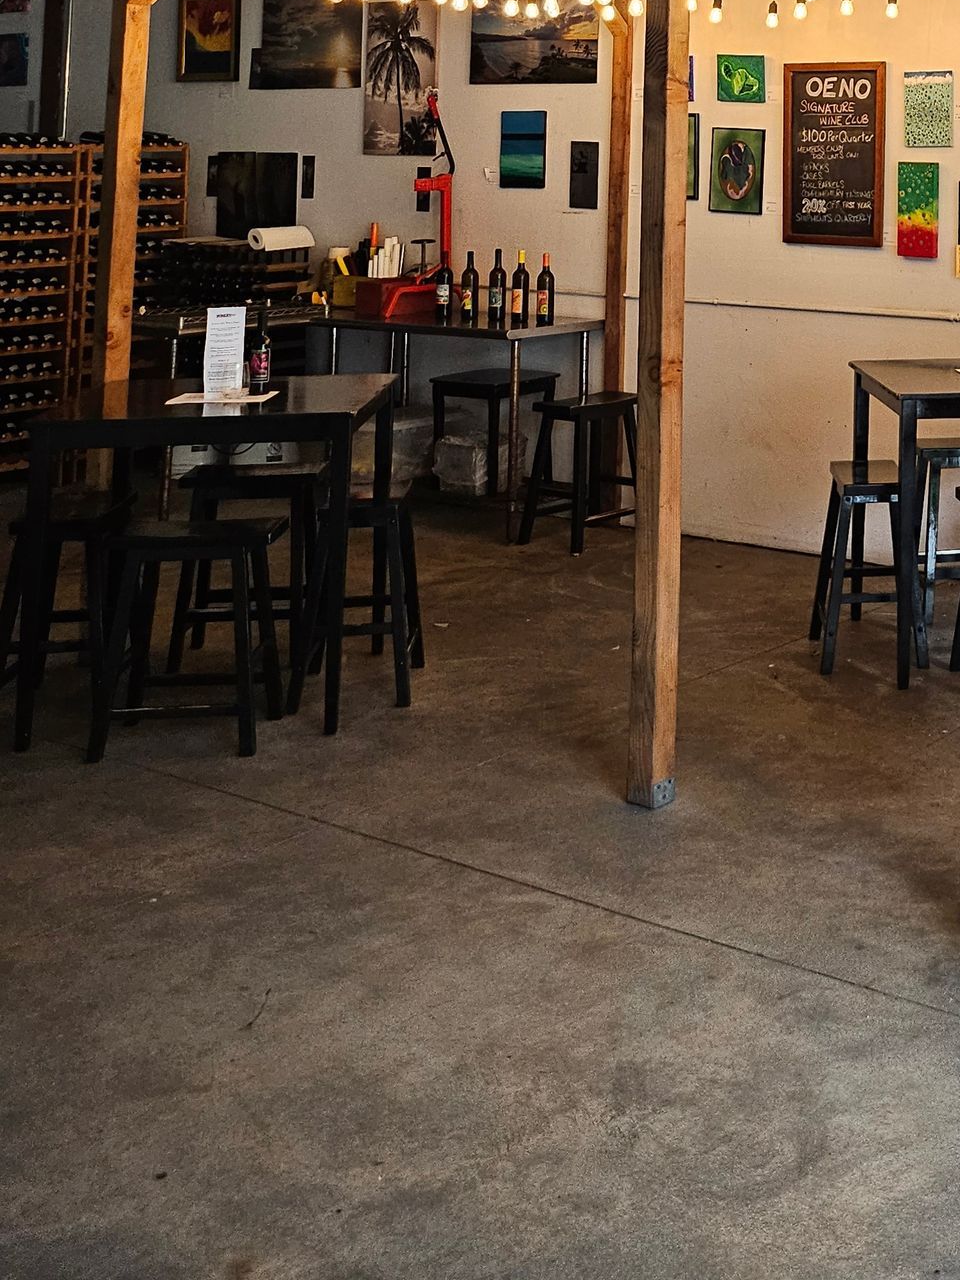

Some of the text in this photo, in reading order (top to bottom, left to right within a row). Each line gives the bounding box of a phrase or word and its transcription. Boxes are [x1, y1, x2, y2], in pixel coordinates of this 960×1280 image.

[806, 76, 871, 99] OENO
[800, 100, 855, 114] SIGNATURE
[820, 113, 869, 126] WINE CLUB
[801, 127, 826, 142] $100
[802, 198, 827, 213] 20%
